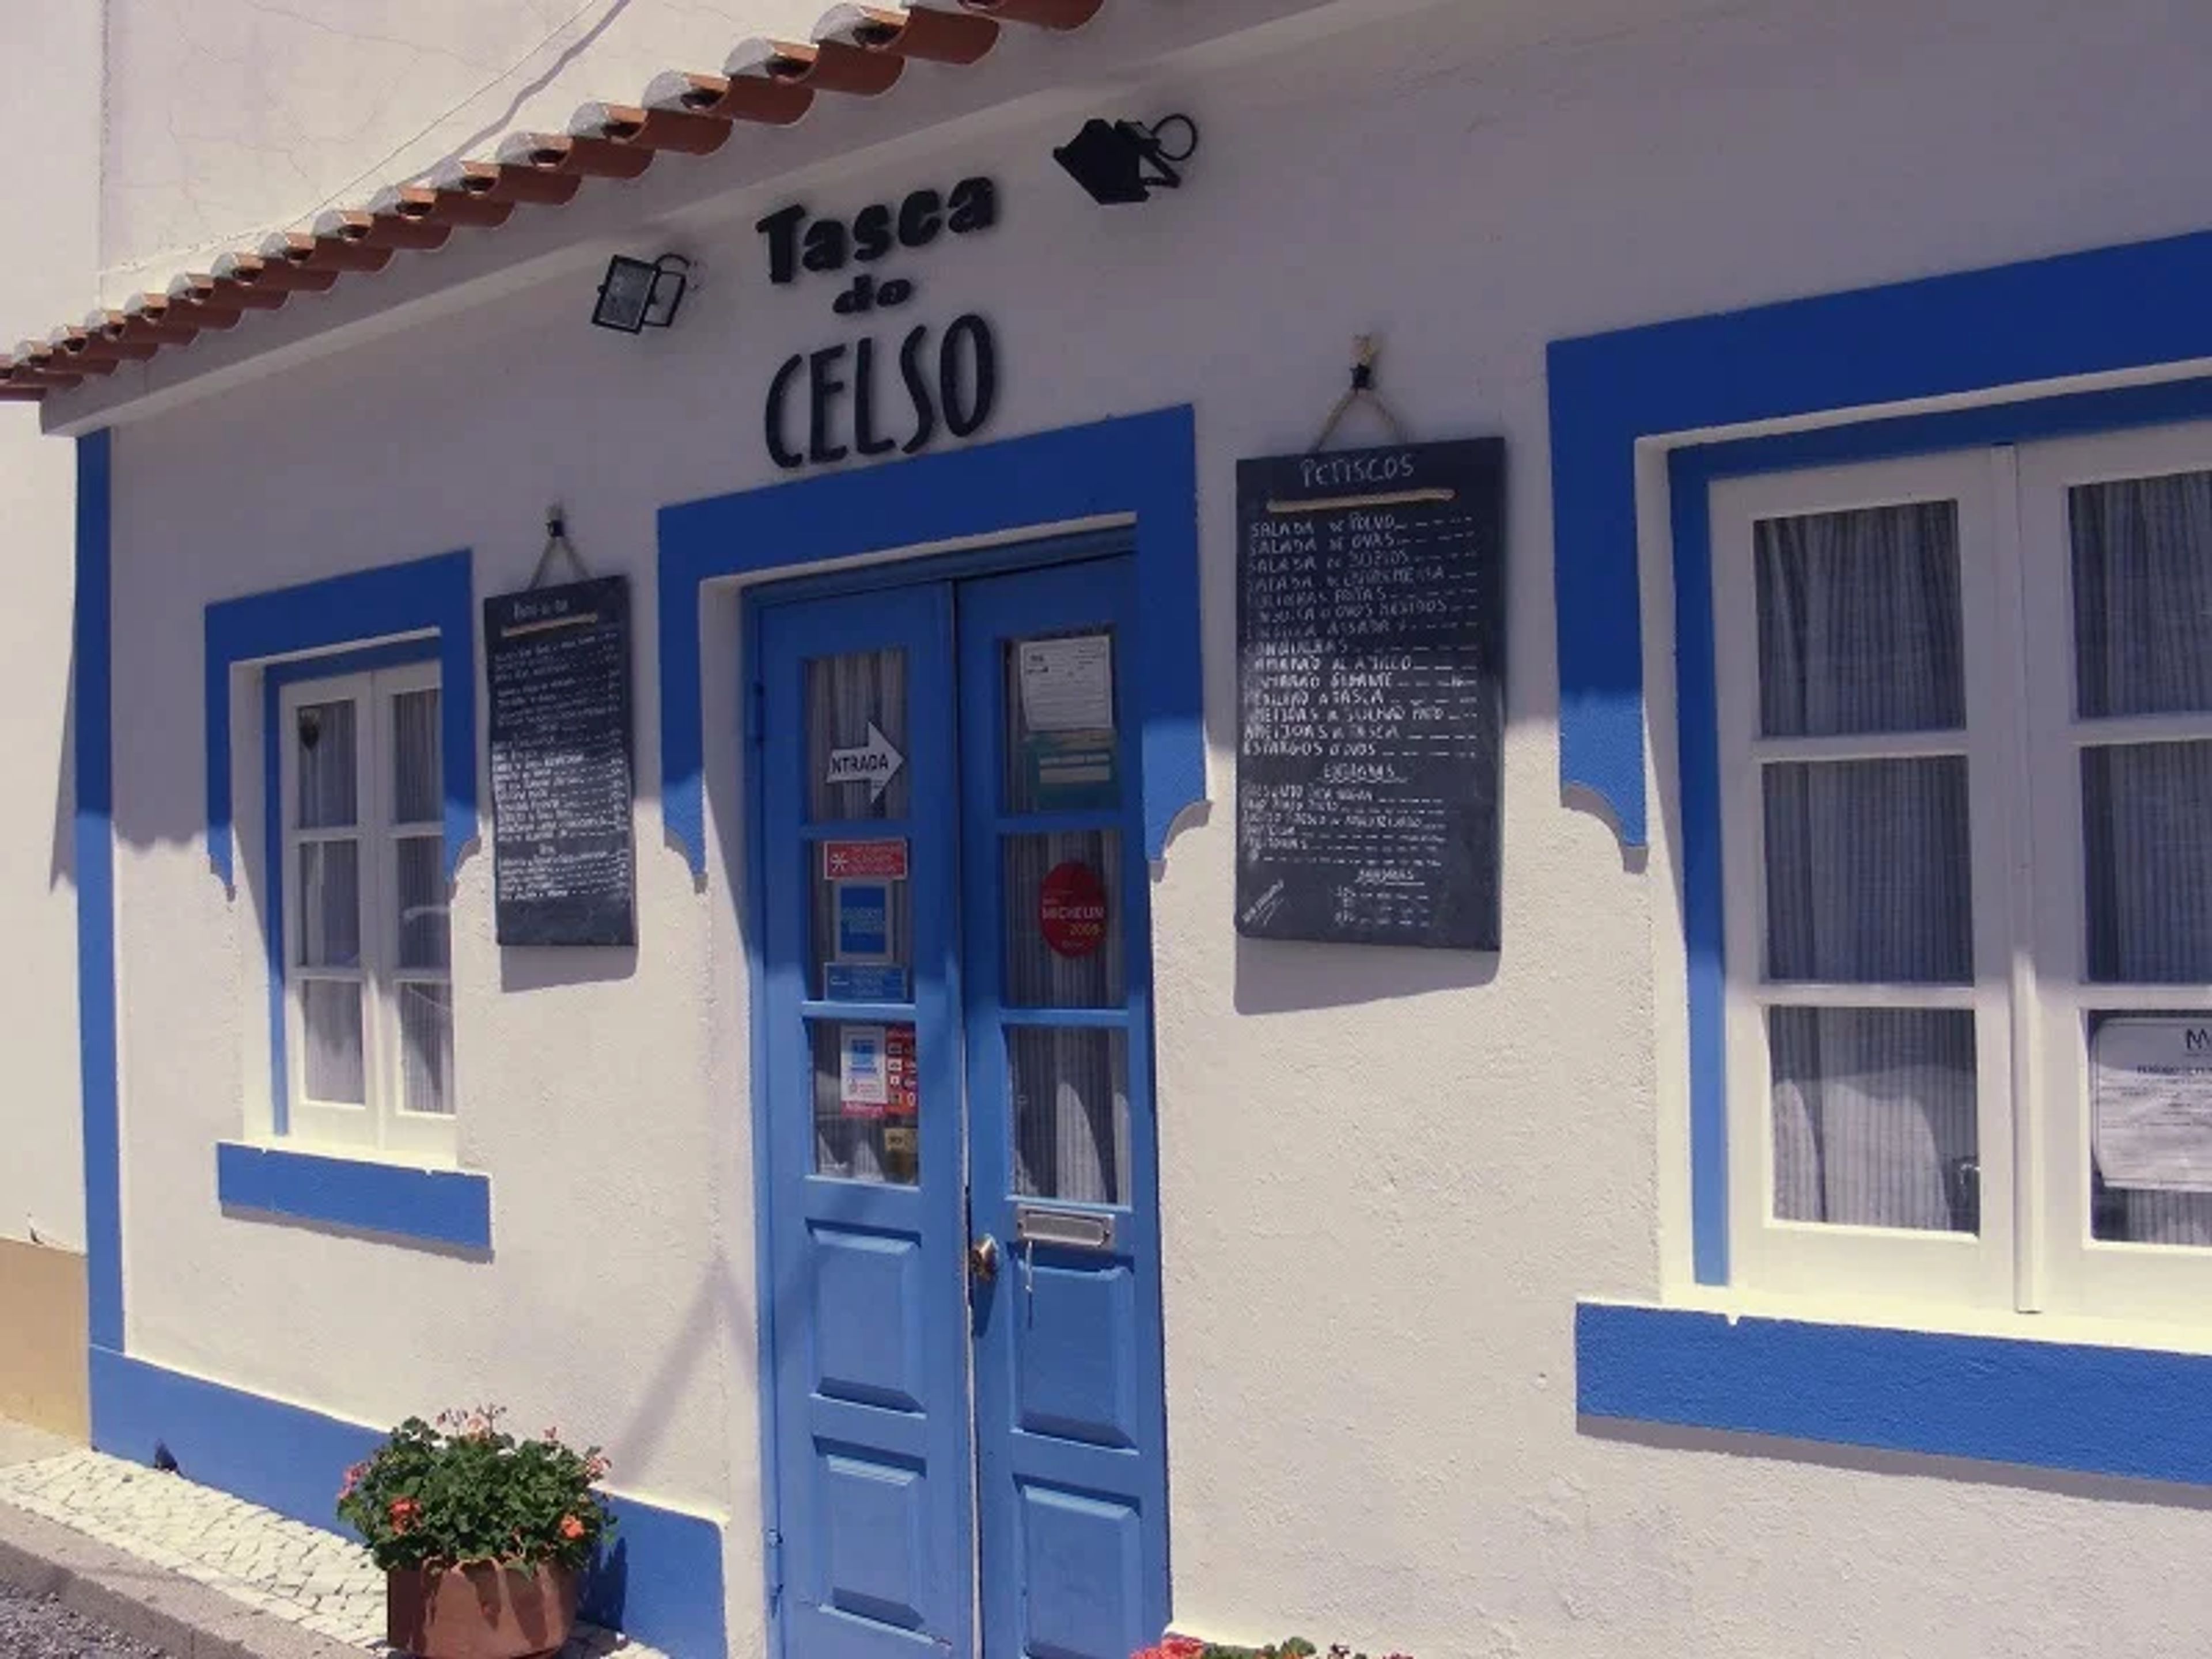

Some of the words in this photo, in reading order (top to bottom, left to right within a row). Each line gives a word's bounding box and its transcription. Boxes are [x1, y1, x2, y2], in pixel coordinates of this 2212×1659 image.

[755, 177, 995, 283] Tasca
[833, 275, 911, 314] do
[765, 314, 995, 468] CELSO
[1300, 454, 1415, 487] PETISCOS
[1249, 538, 1317, 556] SALADA
[1250, 522, 1315, 538] SALADA
